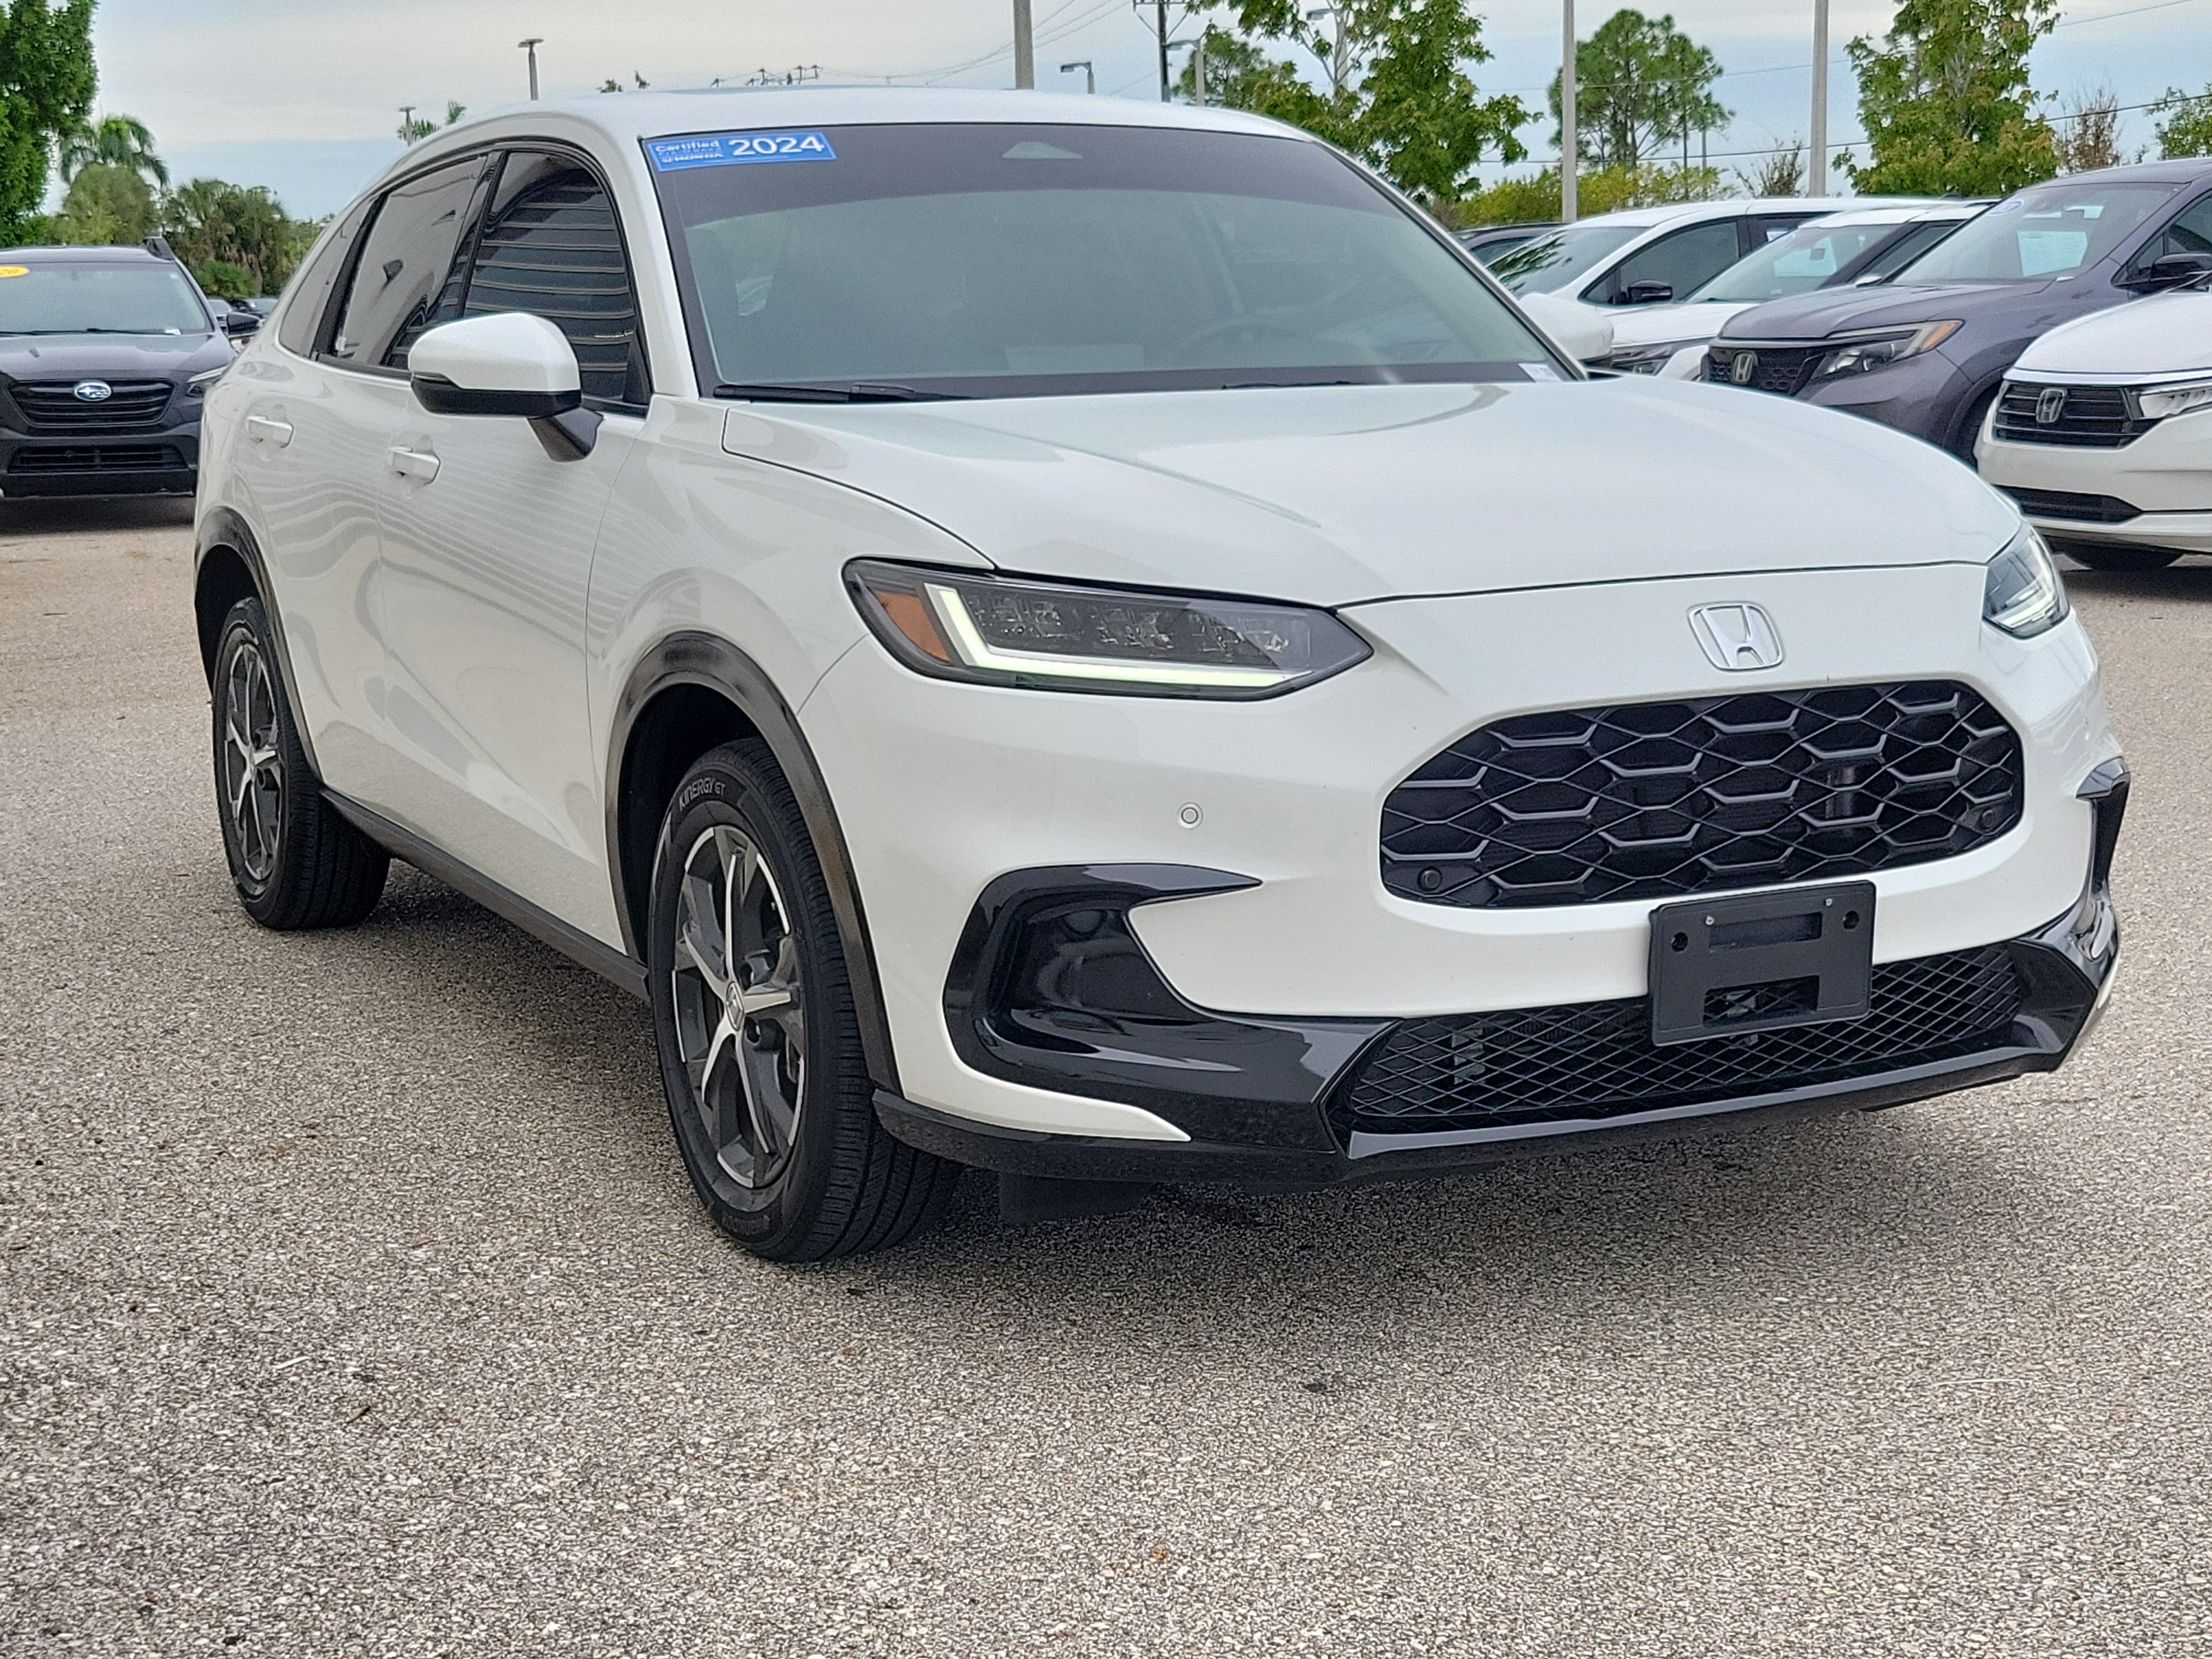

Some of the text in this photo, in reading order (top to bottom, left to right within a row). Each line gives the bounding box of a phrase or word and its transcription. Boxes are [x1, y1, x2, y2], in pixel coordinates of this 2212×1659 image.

[656, 140, 719, 152] Certified
[729, 136, 825, 156] 2024
[679, 777, 714, 812] KINERGY
